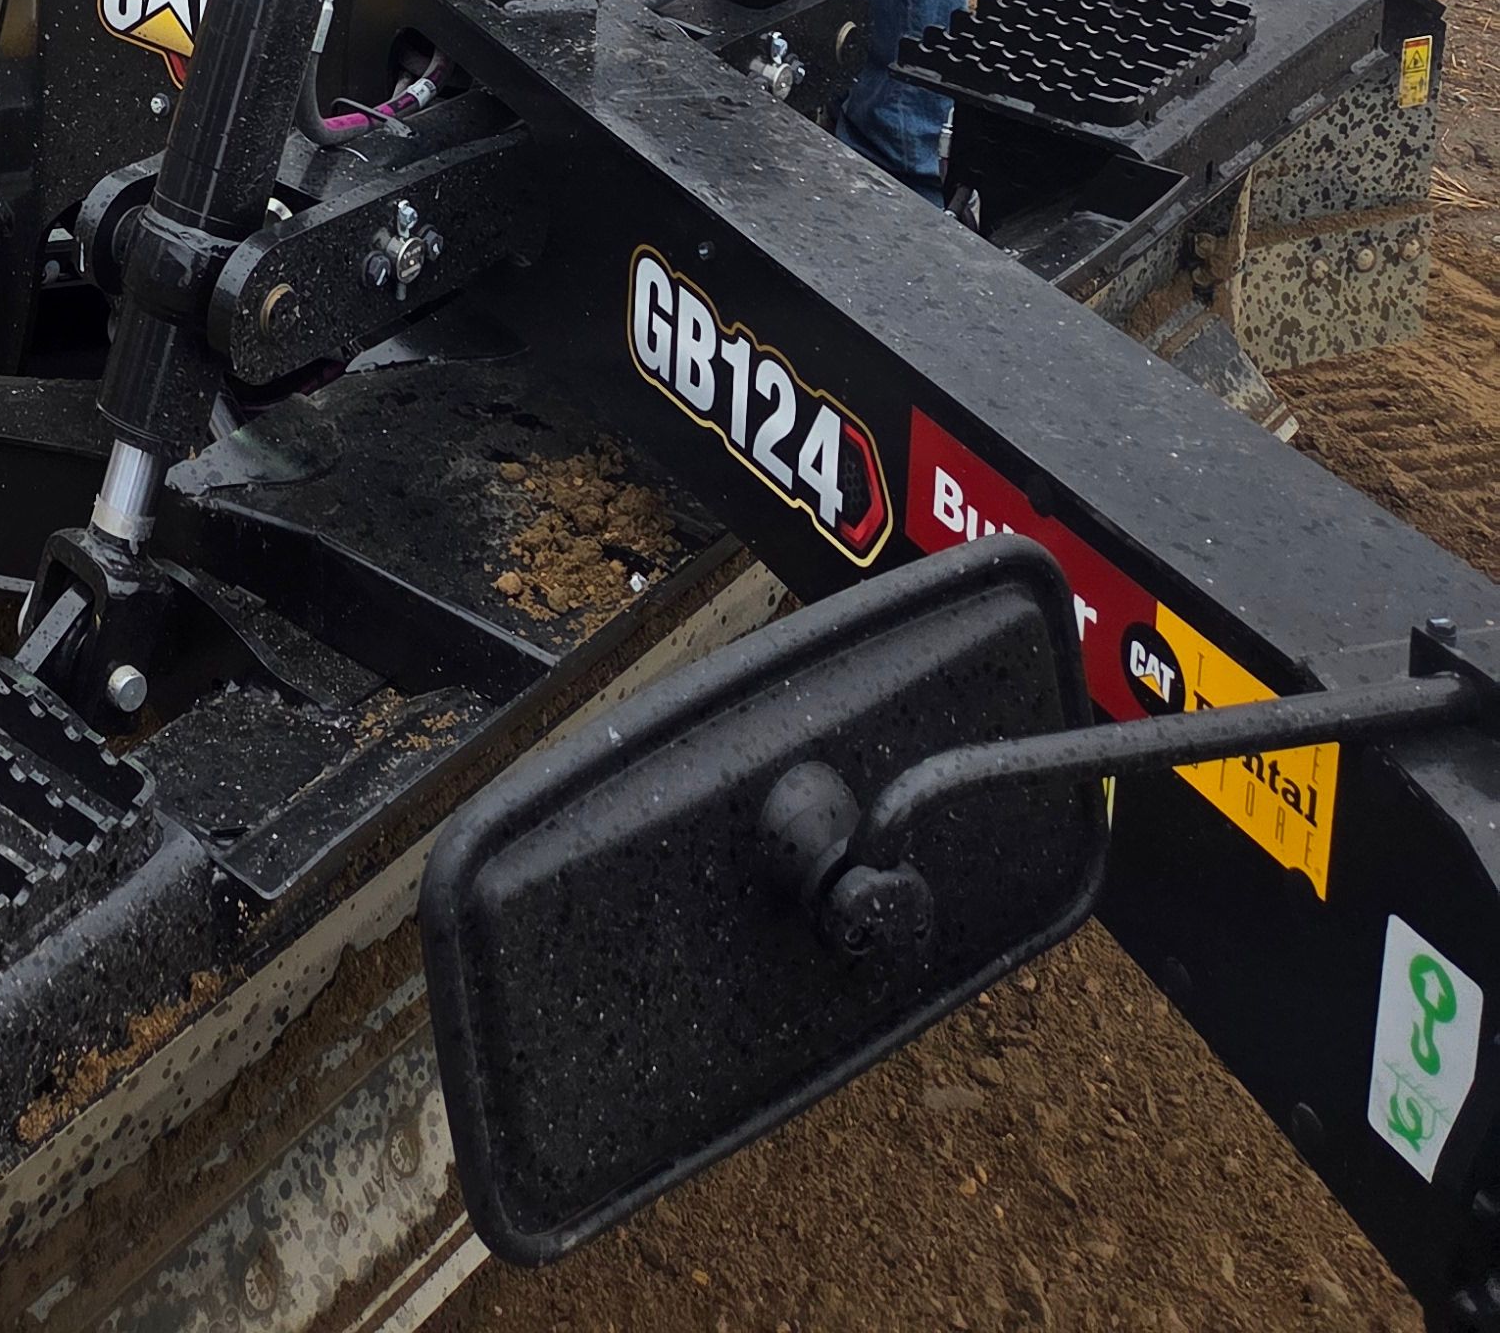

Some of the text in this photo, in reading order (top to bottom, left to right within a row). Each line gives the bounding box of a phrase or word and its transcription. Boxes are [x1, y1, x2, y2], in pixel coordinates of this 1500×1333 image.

[633, 256, 844, 529] GB124
[1129, 640, 1176, 704] CAT
[1189, 755, 1315, 871] TORE
